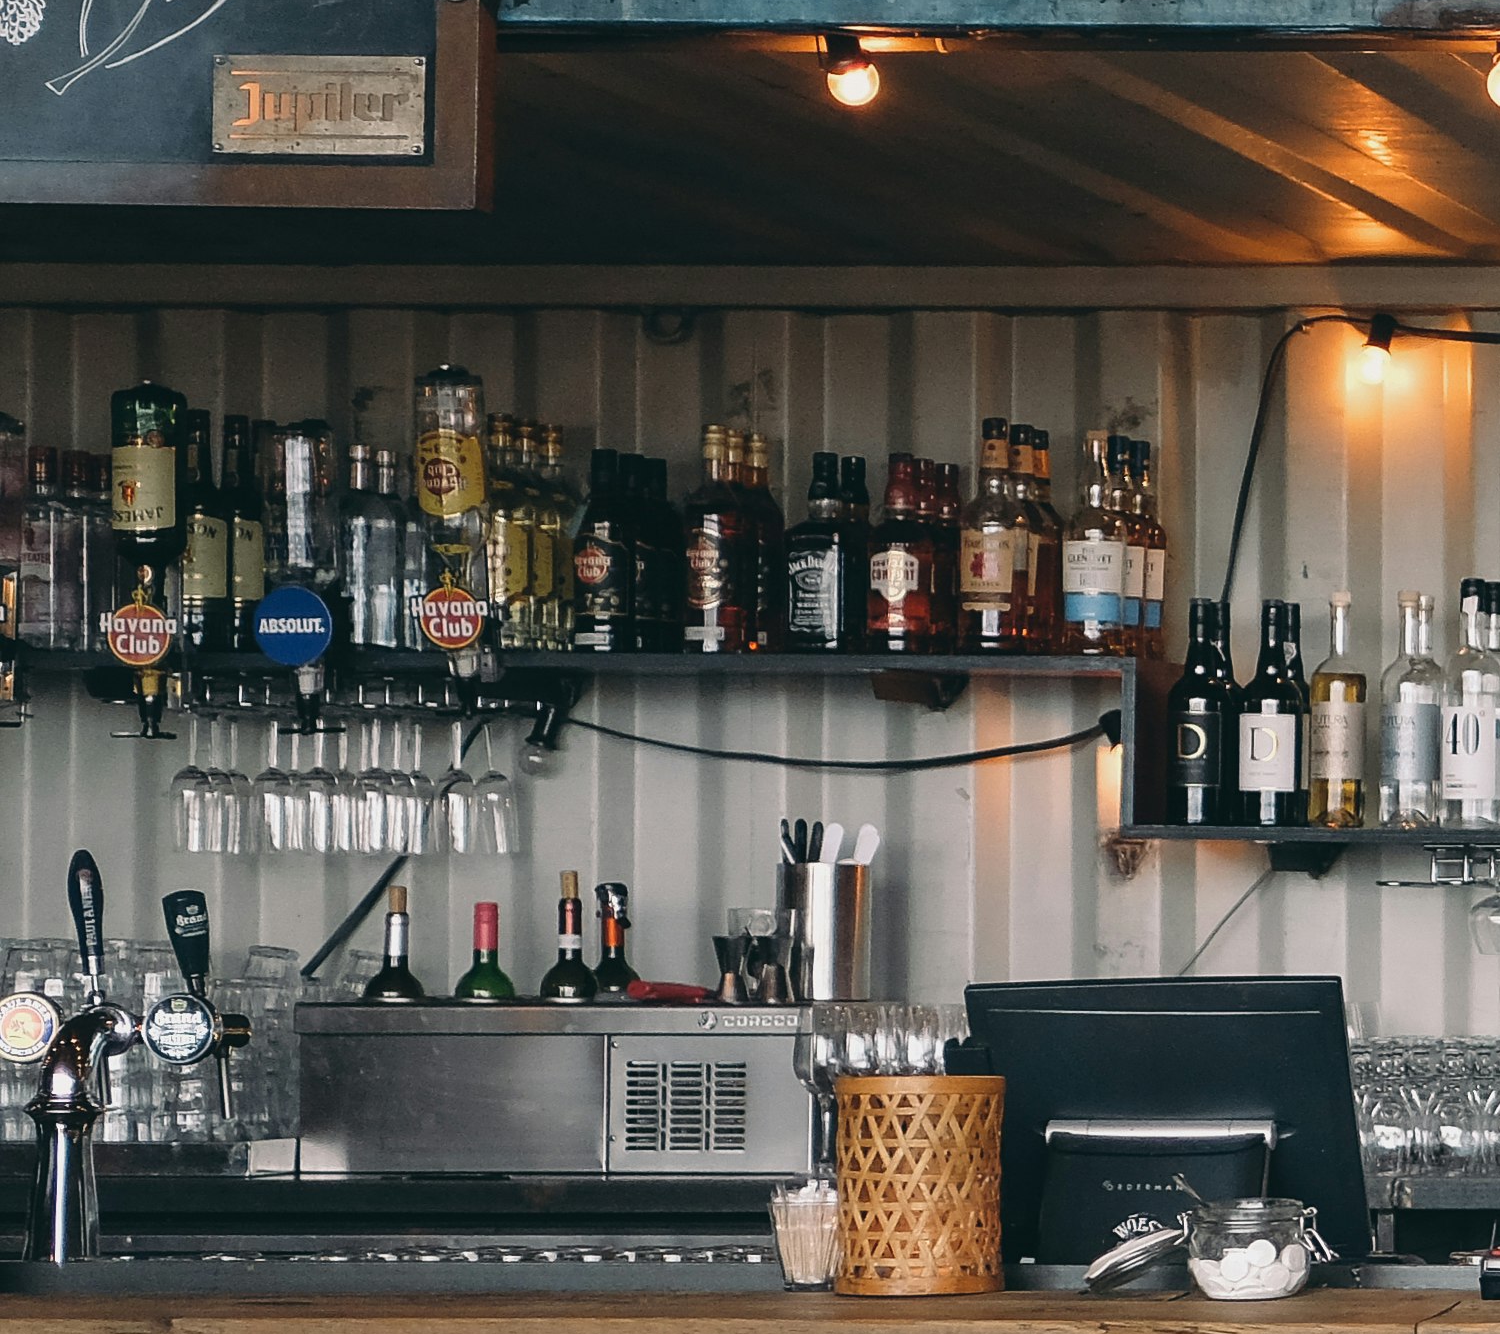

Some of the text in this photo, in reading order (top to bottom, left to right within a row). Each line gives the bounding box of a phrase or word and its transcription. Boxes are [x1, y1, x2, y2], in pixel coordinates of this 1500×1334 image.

[231, 82, 411, 134] Jupiler
[411, 596, 489, 619] Havana
[98, 611, 178, 635] Havana
[427, 617, 475, 638] Club
[115, 633, 161, 655] Club
